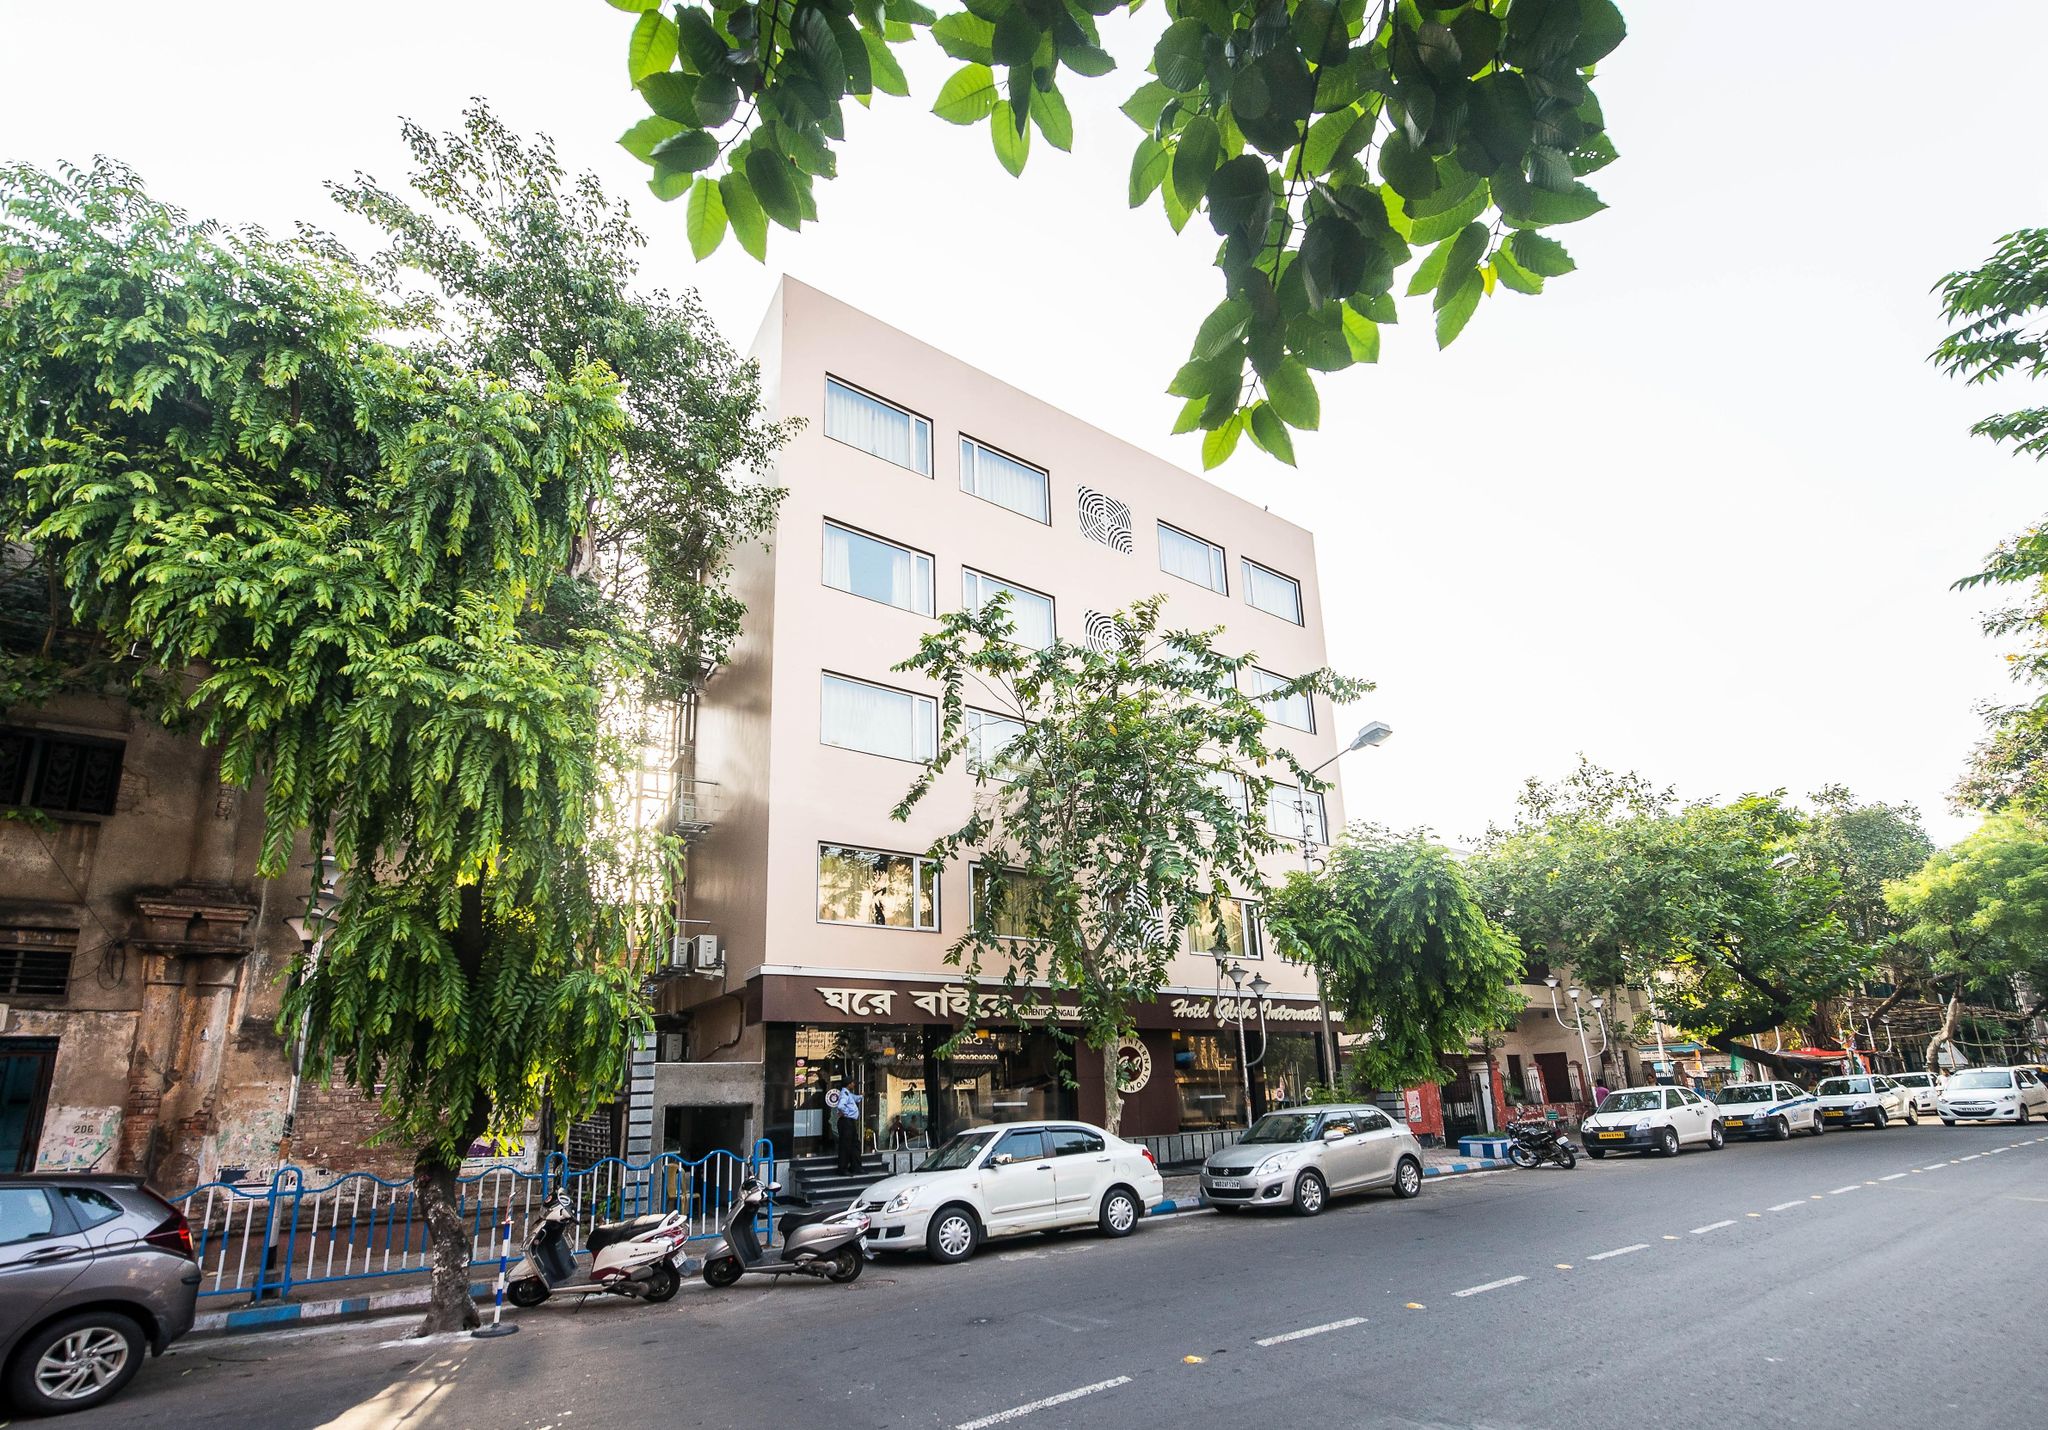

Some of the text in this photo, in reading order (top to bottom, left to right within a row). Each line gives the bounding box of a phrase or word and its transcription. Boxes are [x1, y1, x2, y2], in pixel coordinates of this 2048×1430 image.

[815, 983, 1013, 1018] ঘরে বাইরে
[1170, 998, 1209, 1018] Hotel
[1214, 998, 1257, 1027] Globe
[73, 1124, 94, 1134] 206
